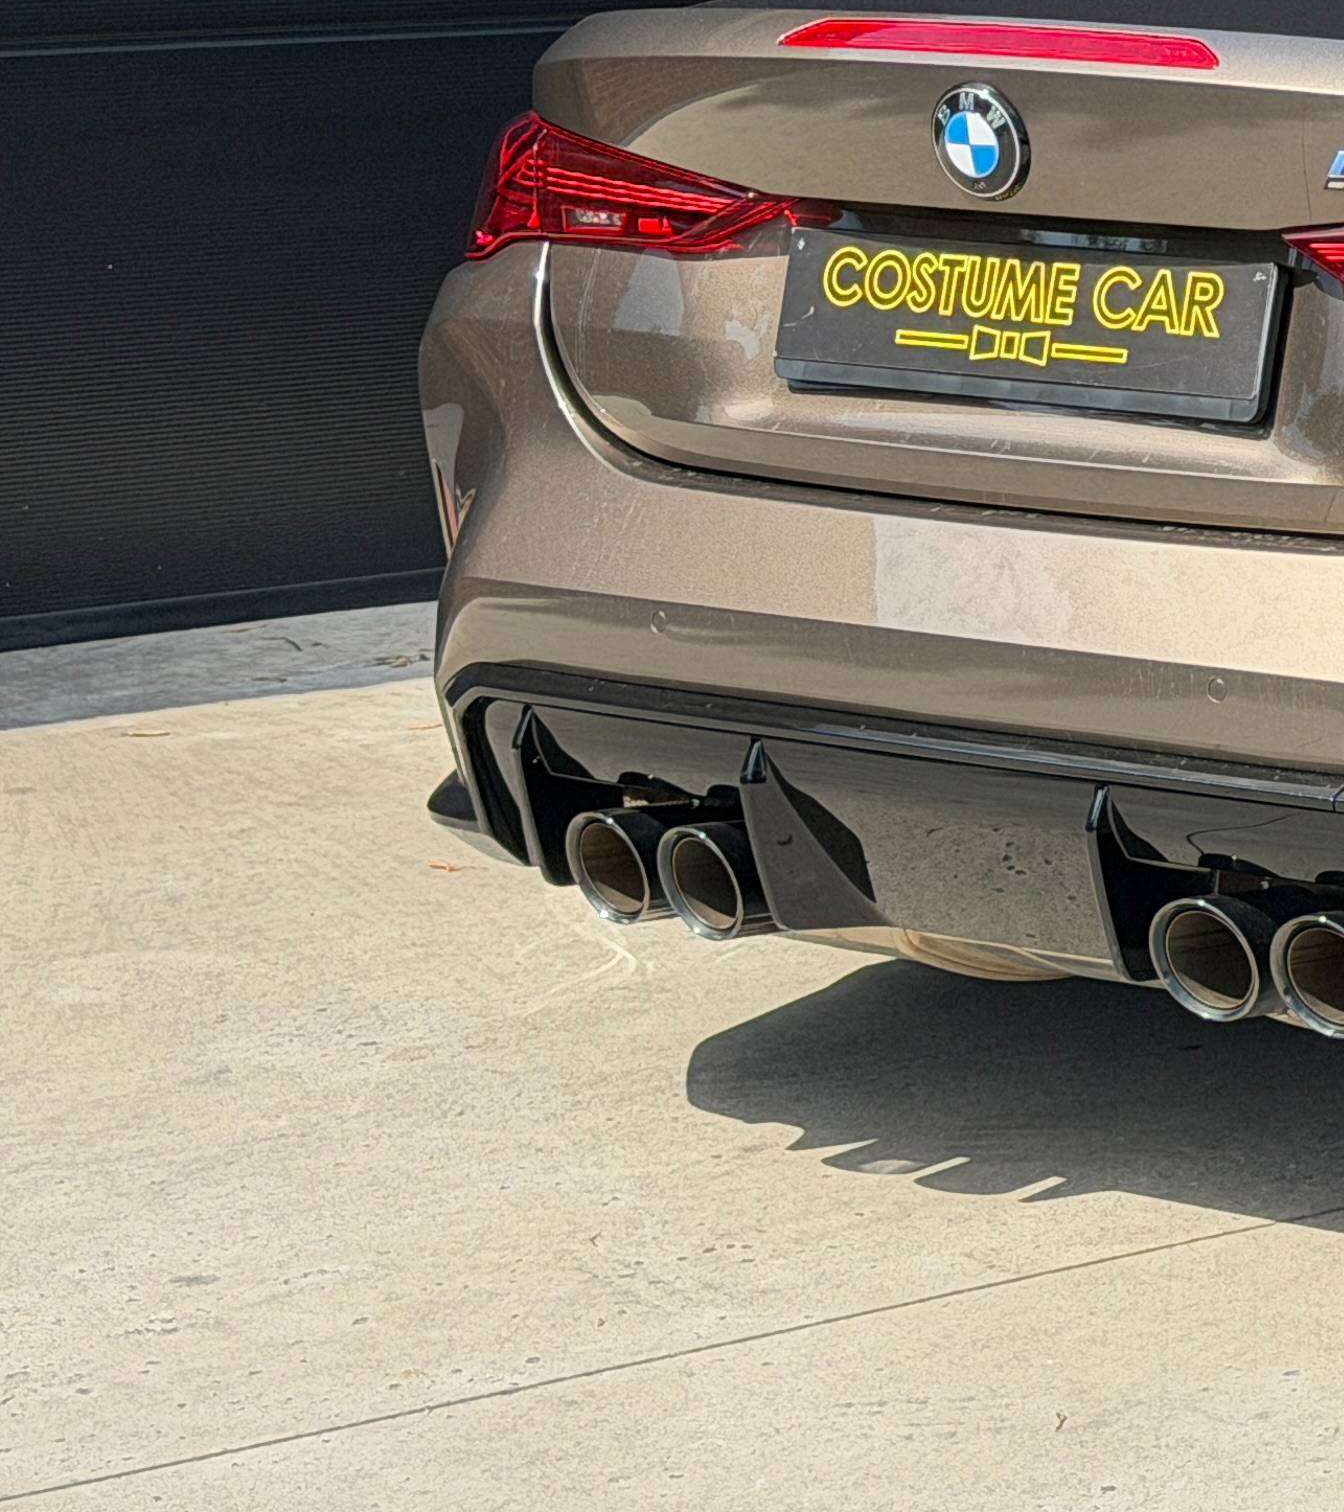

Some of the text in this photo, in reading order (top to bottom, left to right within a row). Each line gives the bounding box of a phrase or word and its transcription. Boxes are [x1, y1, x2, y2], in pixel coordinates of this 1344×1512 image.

[938, 91, 1006, 129] BMW
[823, 246, 1225, 339] COSTUME CAR
